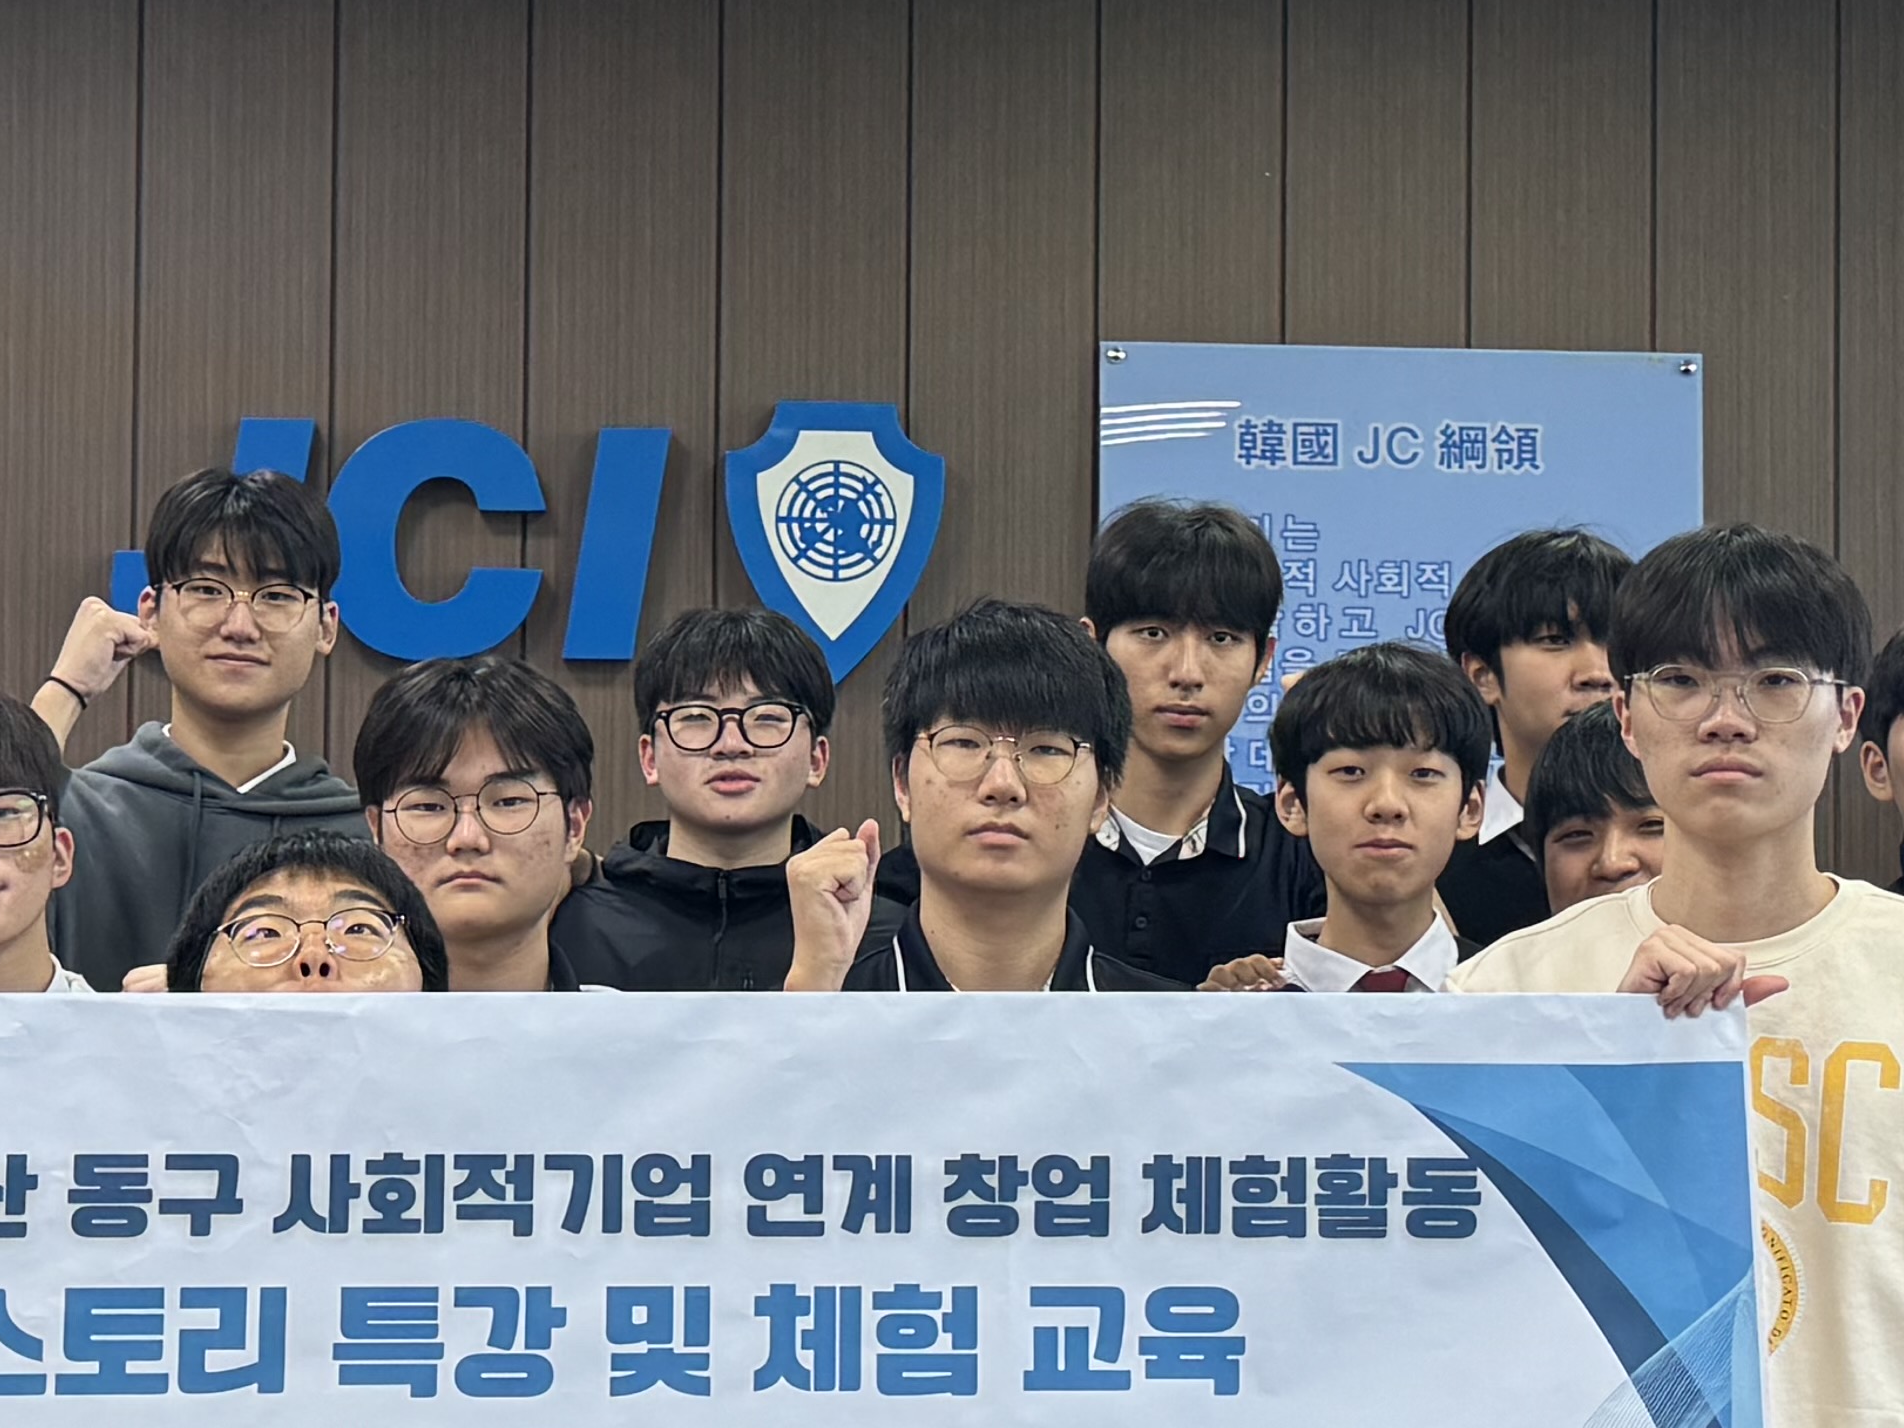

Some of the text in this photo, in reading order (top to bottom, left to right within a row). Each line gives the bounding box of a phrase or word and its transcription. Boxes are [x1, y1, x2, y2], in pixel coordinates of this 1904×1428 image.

[1236, 418, 1543, 473] 韓國 JC 綱領
[1333, 560, 1452, 598] 사회적
[1274, 606, 1377, 640] 하고
[67, 1153, 243, 1239] 동구
[272, 1152, 713, 1238] 사회적기업
[745, 1153, 916, 1239] 연계
[942, 1153, 1111, 1239] 창업
[1142, 1154, 1484, 1241] 체험활동
[331, 1284, 568, 1400] 특강
[604, 1284, 713, 1398] 및
[752, 1284, 982, 1398] 체험
[1021, 1285, 1247, 1397] 교육
